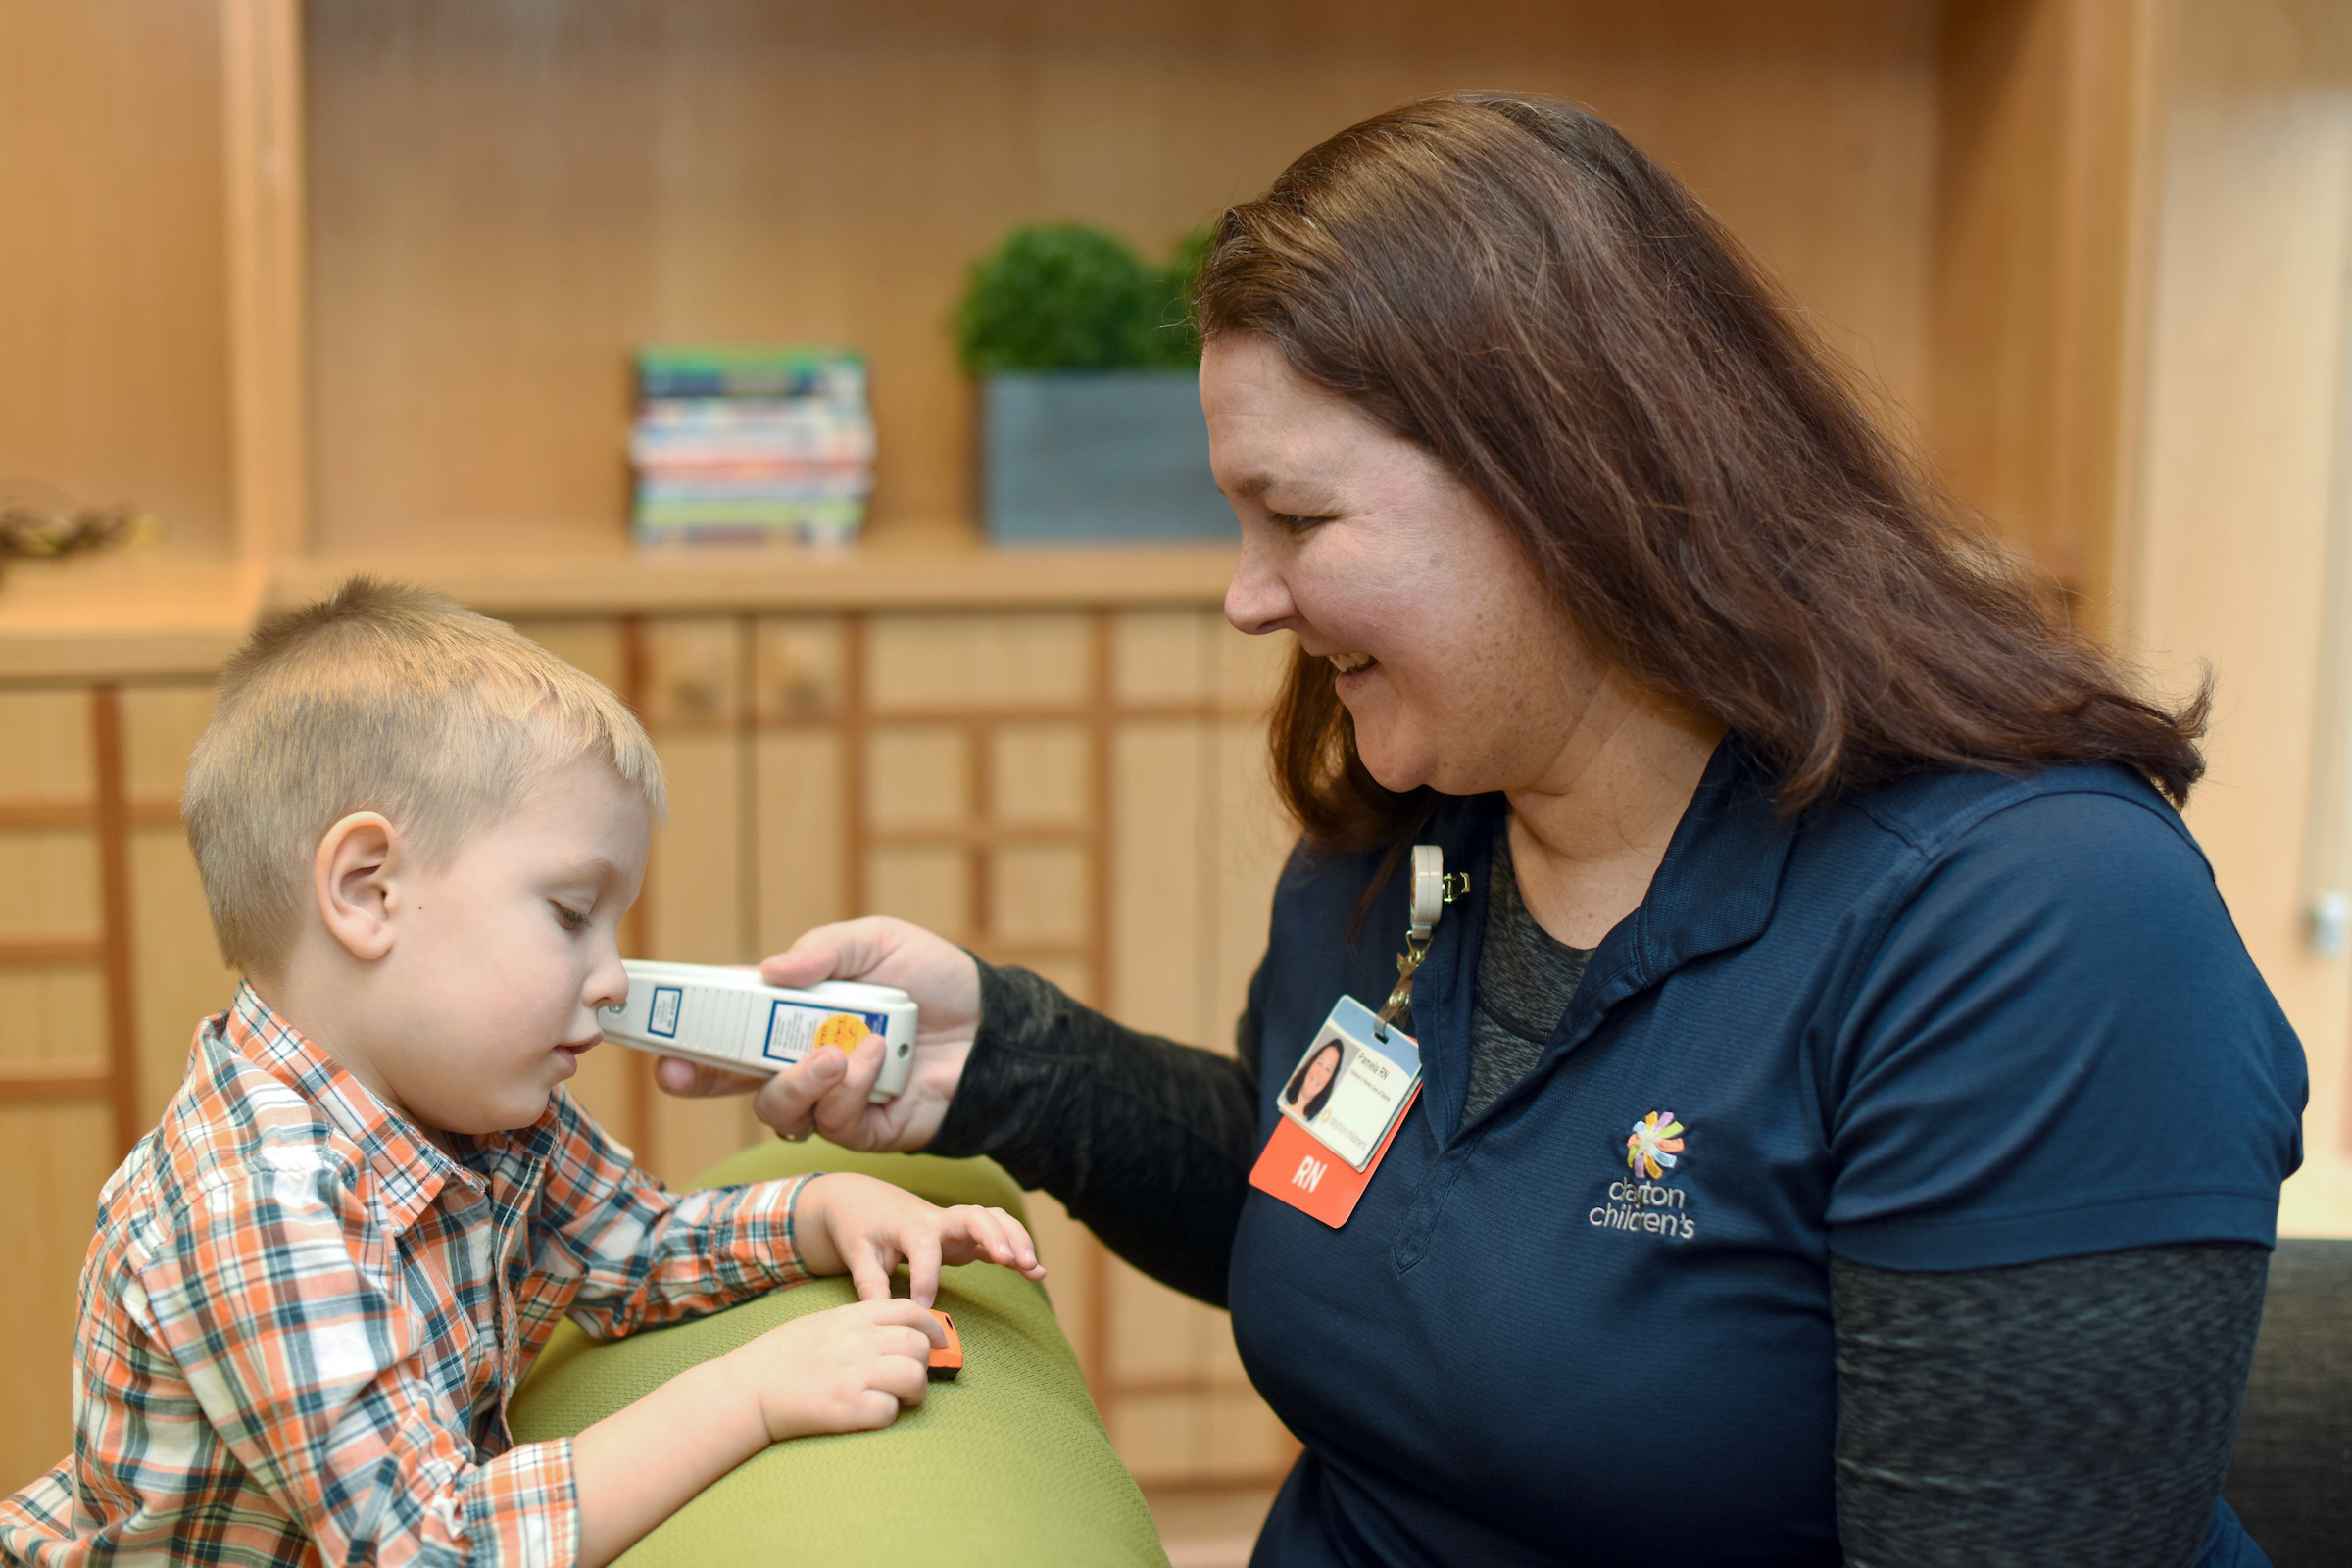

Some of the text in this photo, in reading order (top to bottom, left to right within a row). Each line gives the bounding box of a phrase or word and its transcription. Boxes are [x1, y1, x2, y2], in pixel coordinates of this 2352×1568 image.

[1357, 1052, 1390, 1080] Pamela RN
[1330, 1117, 1348, 1133] dayton
[1291, 1154, 1328, 1193] RN
